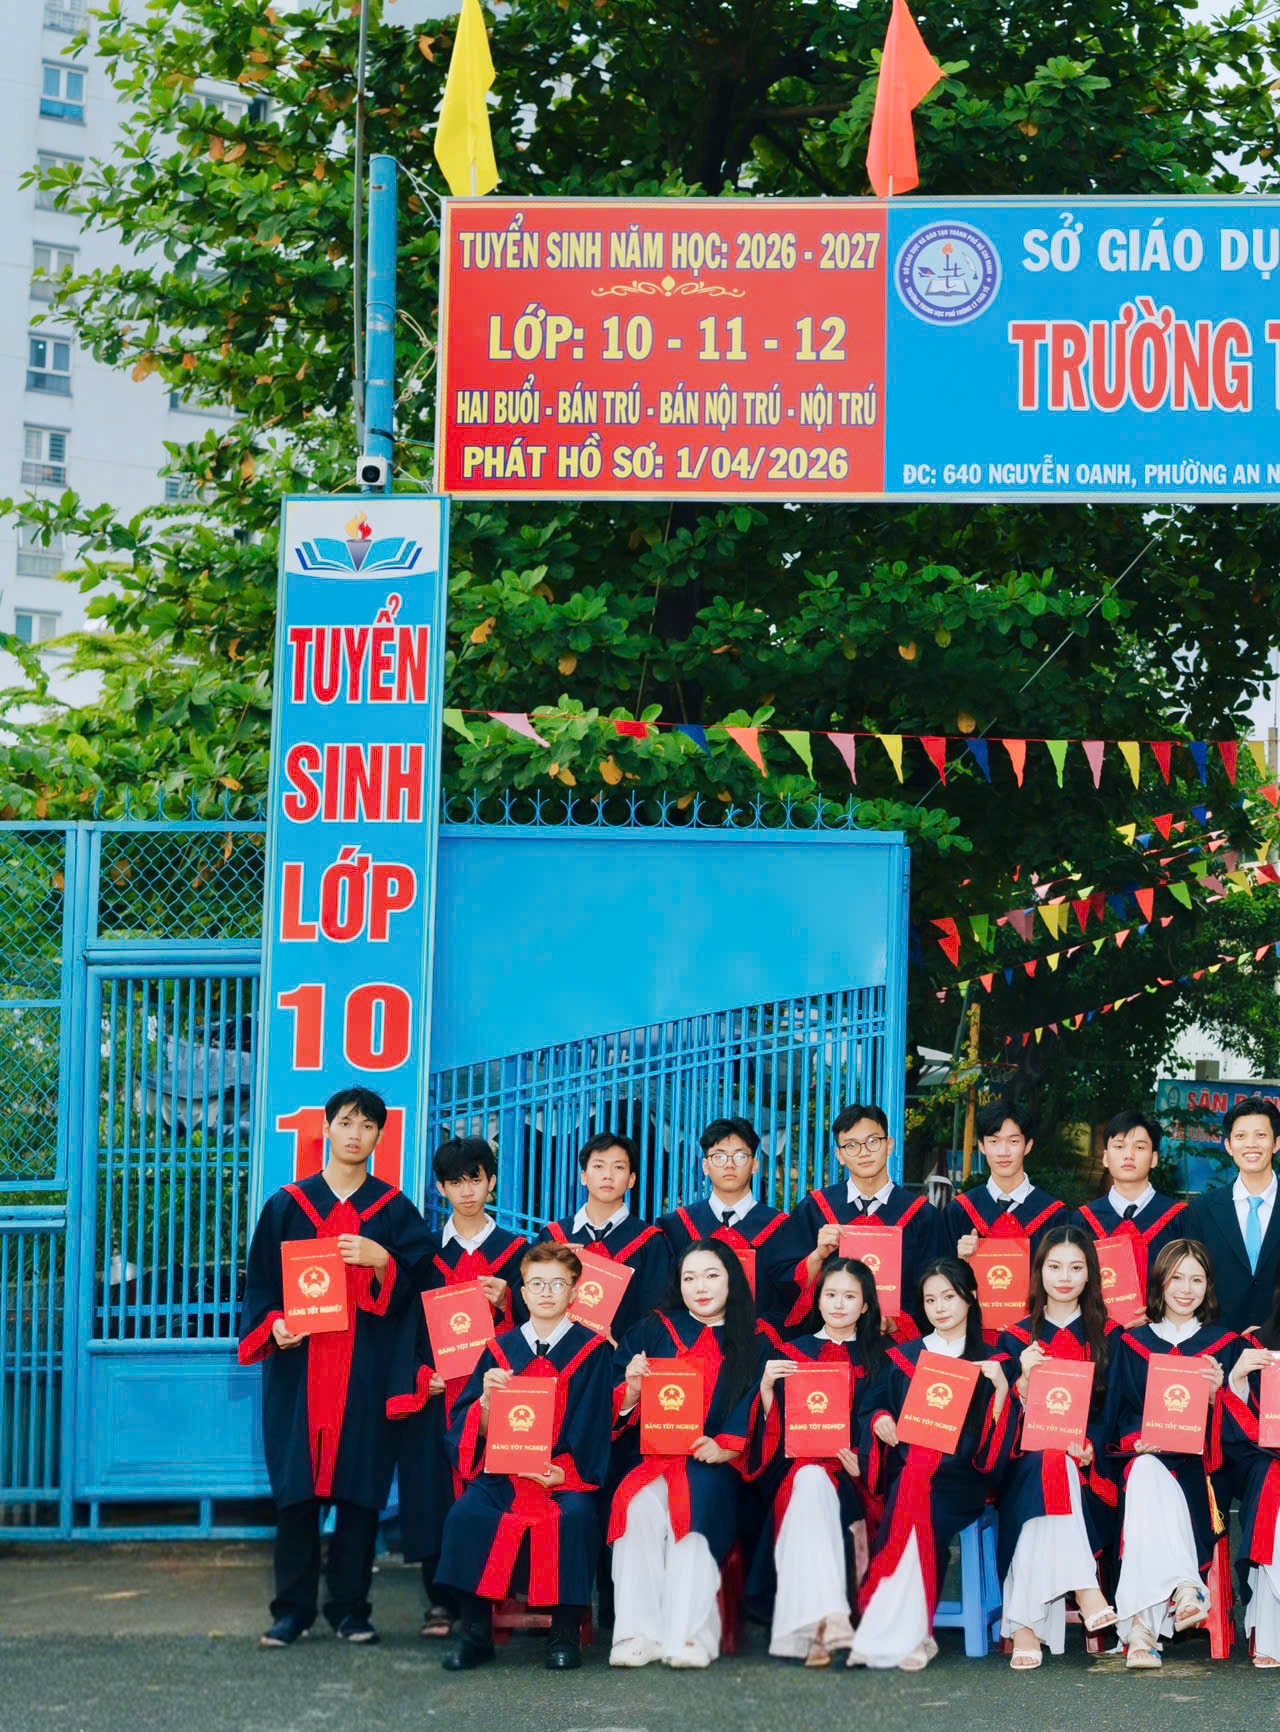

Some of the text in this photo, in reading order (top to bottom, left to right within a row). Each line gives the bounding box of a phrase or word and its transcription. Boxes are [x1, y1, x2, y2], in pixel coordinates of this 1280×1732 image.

[459, 212, 881, 277] TUYỂN SINH NĂM HỌC: 2026 - 2027
[1022, 211, 1084, 272] SỞ
[1097, 217, 1203, 272] GIÁO
[488, 303, 847, 362] LỚP: 10 - 11 - 12
[1007, 296, 1253, 412] TRƯỜNG
[456, 373, 877, 432] HAI BUỔI - BÁN TRÚ - BÁN NỘI TRÚ - NỘI TRÚ
[463, 432, 849, 480] PHÁT HỒ SƠ: 1/04/2026
[903, 464, 937, 485] ĐC:
[943, 463, 982, 484] 640
[988, 454, 1070, 485] NGUYỄN
[1076, 463, 1137, 488] OANH,
[1144, 458, 1227, 485] PHƯỜNG
[1232, 463, 1260, 484] AN
[287, 592, 430, 705] TUYỂN
[282, 742, 425, 823] SINH
[279, 845, 417, 944] LỚP
[276, 982, 411, 1072] 10
[1187, 1089, 1228, 1113] SÂN
